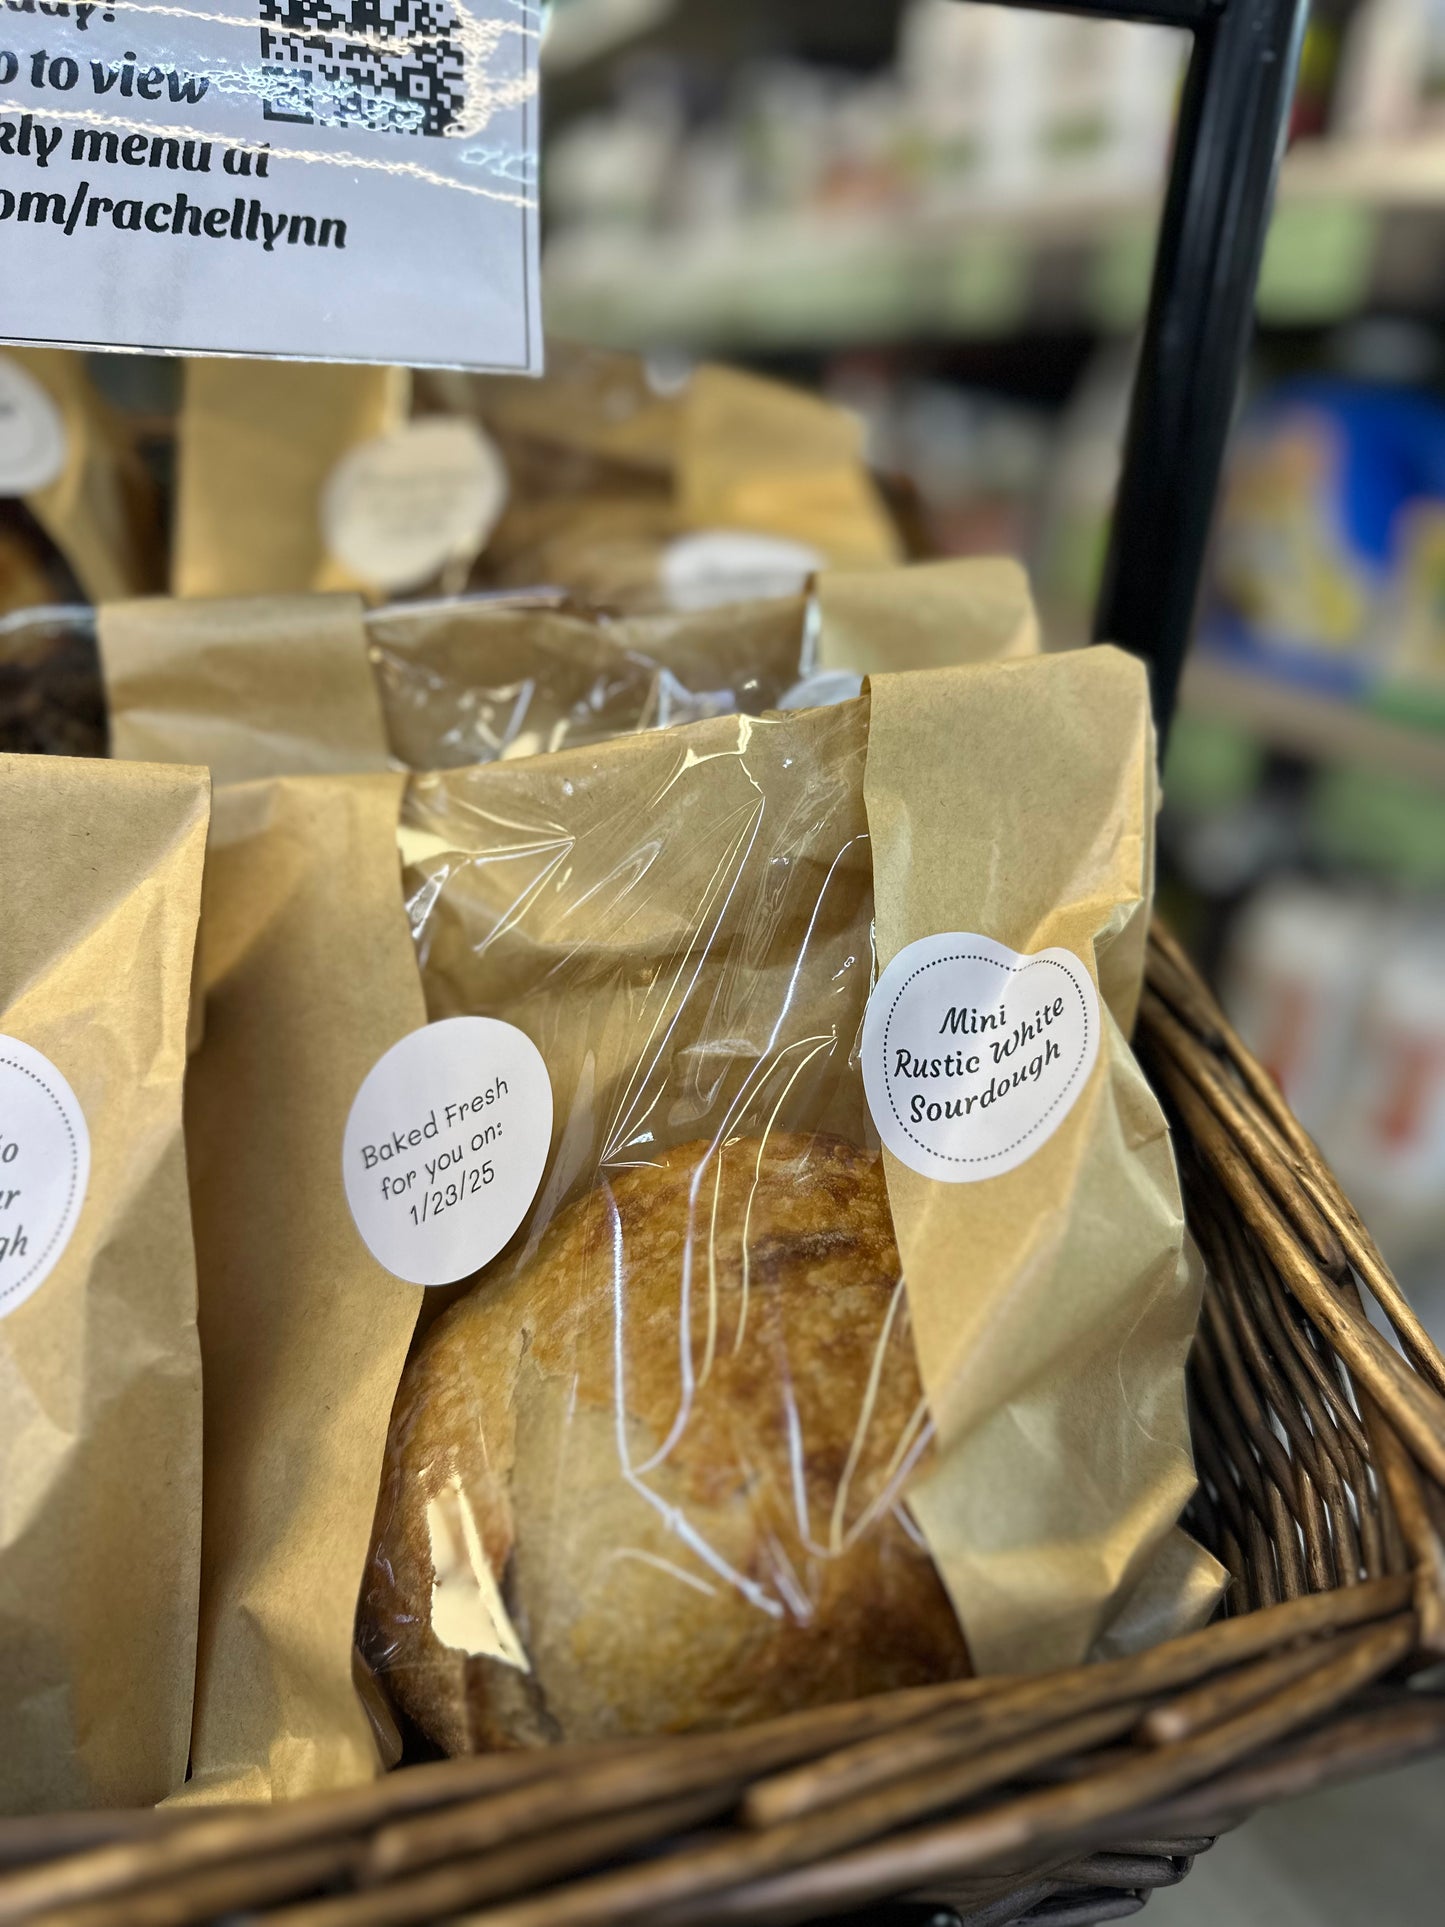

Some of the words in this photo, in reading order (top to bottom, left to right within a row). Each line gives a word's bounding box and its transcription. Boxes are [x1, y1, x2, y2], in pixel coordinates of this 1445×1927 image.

[30, 49, 80, 91] to
[89, 50, 210, 104] view
[70, 128, 213, 173] menu
[893, 1048, 981, 1079] Rustic
[989, 996, 1065, 1065] White
[938, 1004, 1008, 1036] Mini
[909, 1038, 1062, 1124] Sourdough
[361, 1109, 440, 1170] Baked
[443, 1076, 510, 1129] Fresh
[381, 1169, 418, 1201] for
[424, 1145, 464, 1186] you
[470, 1121, 504, 1152] on:
[409, 1159, 496, 1226] 1/23/25
